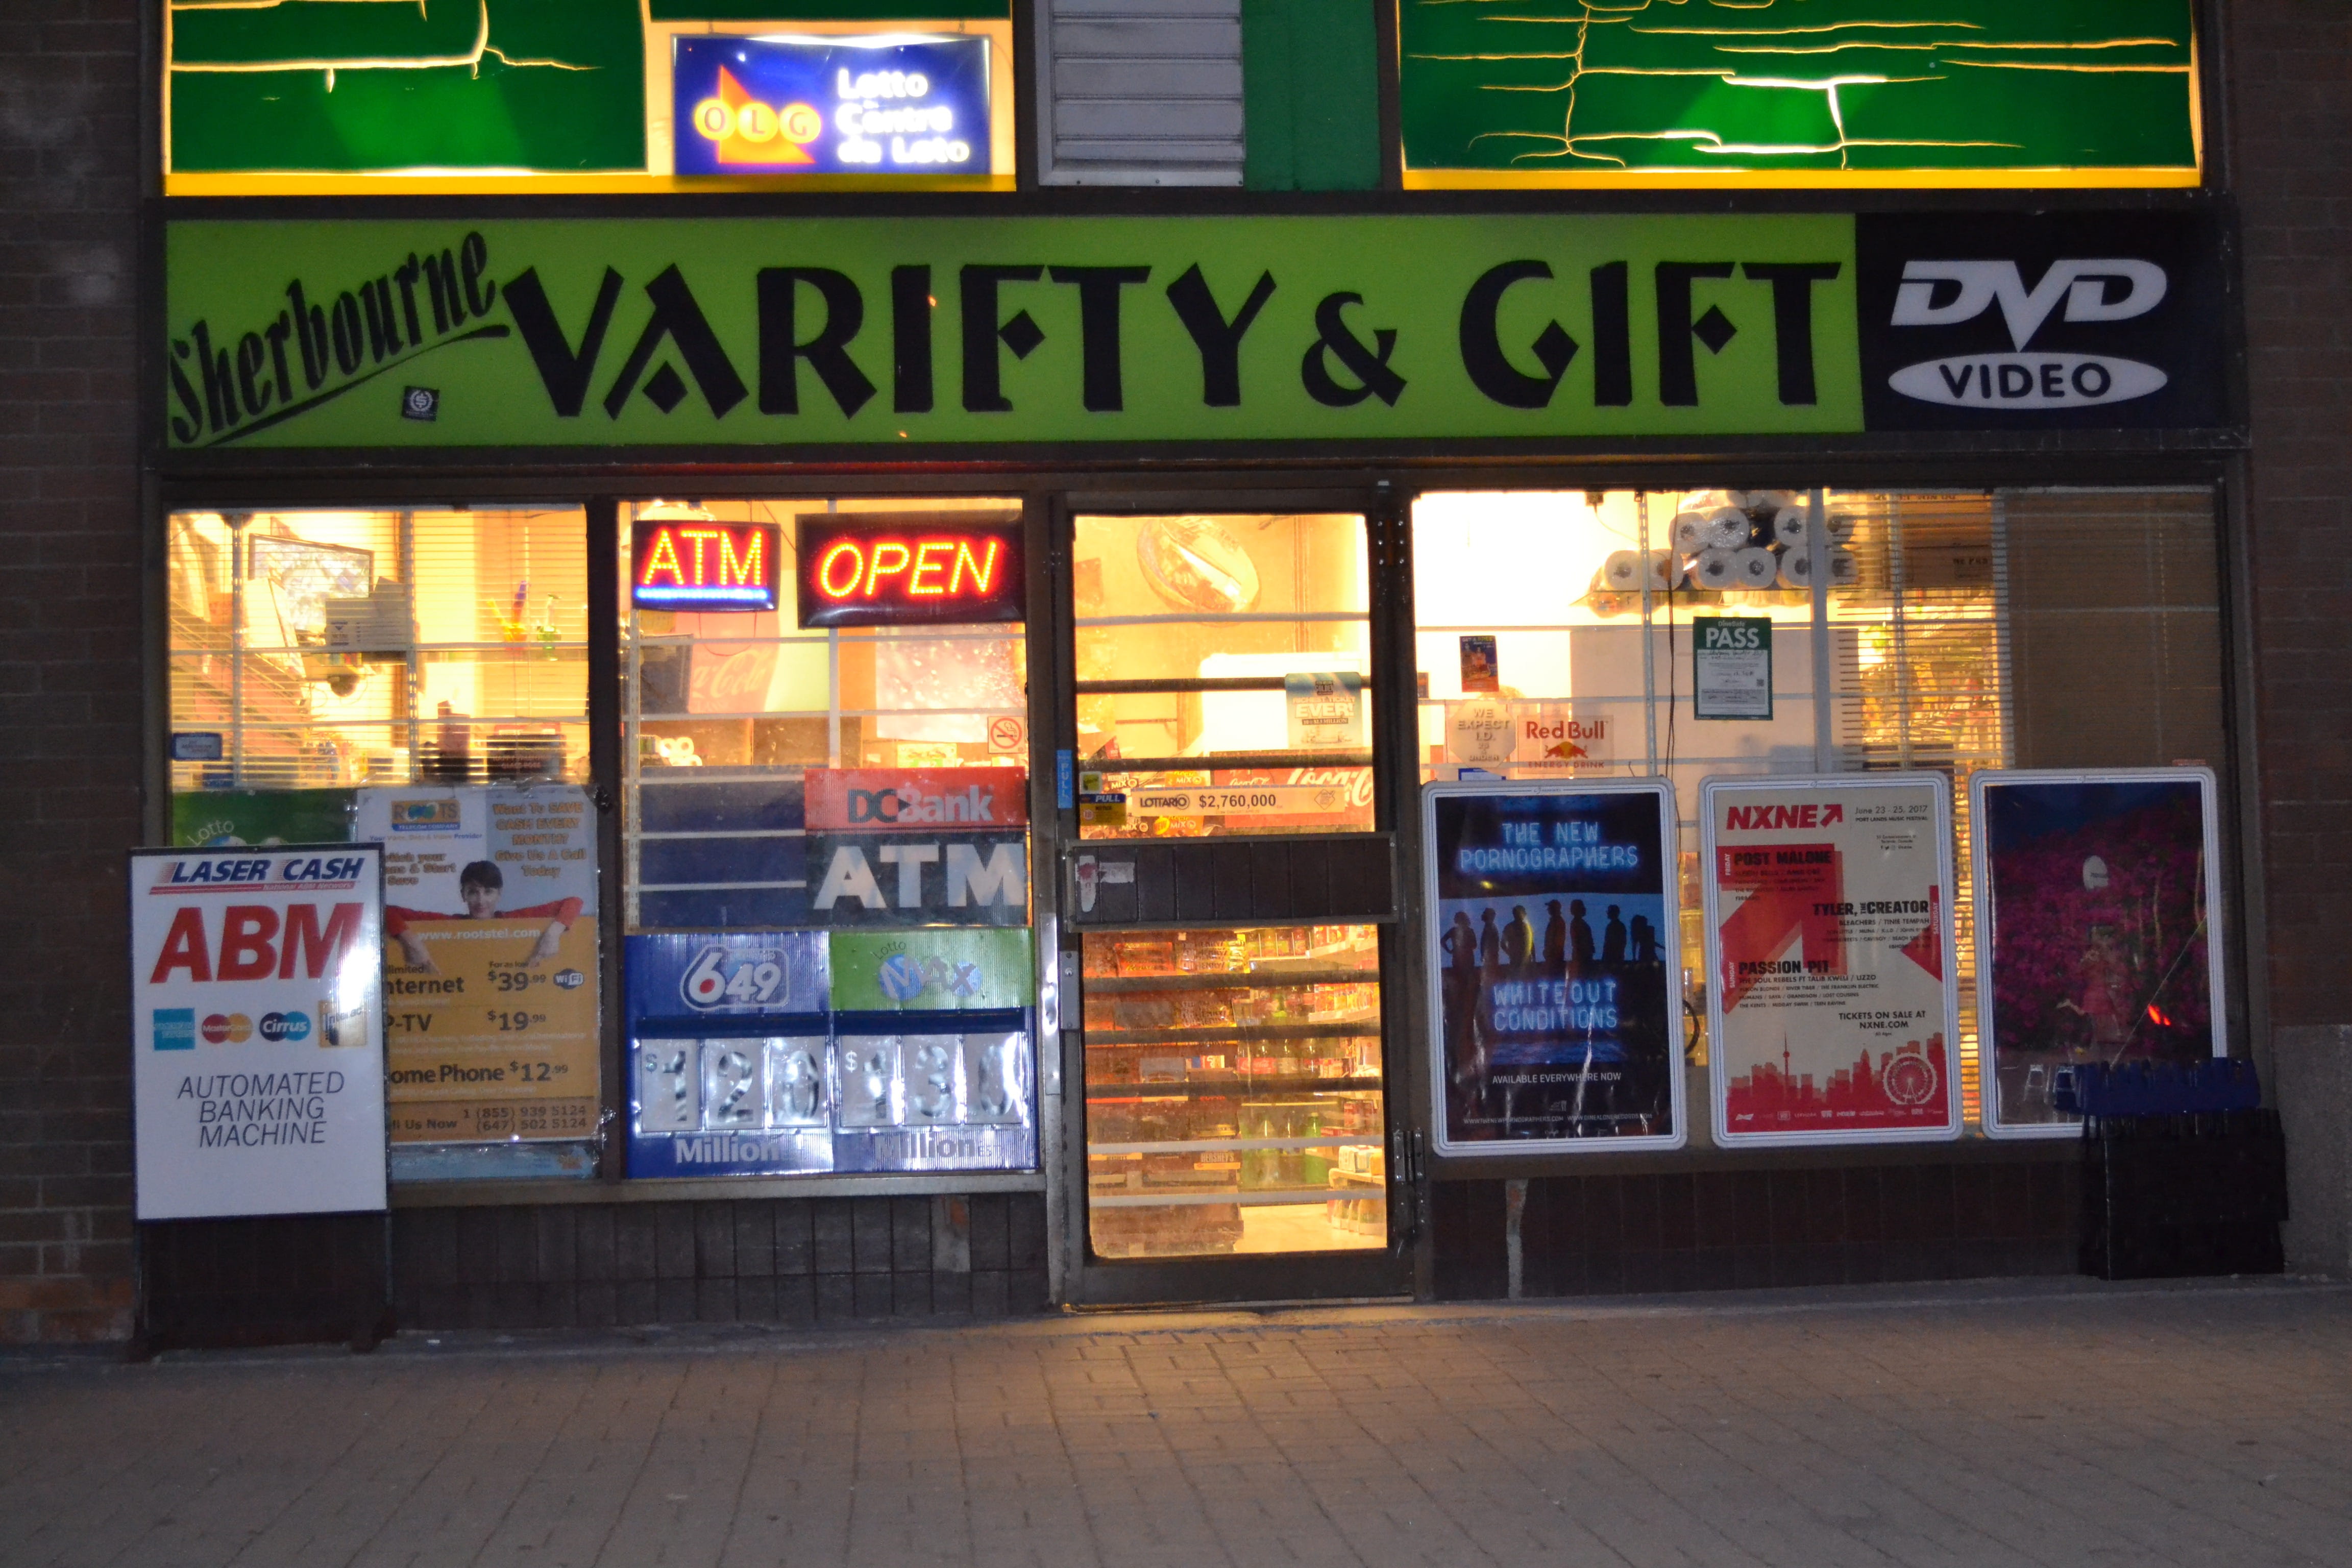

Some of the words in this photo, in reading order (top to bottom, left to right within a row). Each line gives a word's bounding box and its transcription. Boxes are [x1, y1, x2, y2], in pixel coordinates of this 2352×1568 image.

[838, 67, 928, 100] Lotto
[699, 104, 814, 139] OLG
[892, 140, 970, 163] Loto
[1890, 260, 2167, 354] DVD
[170, 231, 496, 444] Sherbourne
[1302, 289, 1407, 408] &
[1458, 258, 1842, 409] GIFT
[1939, 361, 2113, 399] VIDEO
[643, 528, 762, 587] ATM
[819, 541, 997, 598] OPEN
[1706, 627, 1760, 648] PASS
[1295, 702, 1355, 718] EVER!
[1474, 708, 1494, 718] WE
[1458, 720, 1510, 730] EXPECT
[1526, 721, 1564, 739] Red
[1568, 720, 1605, 739] Bull
[1111, 781, 1127, 789] MIX
[493, 804, 527, 815] Want
[529, 802, 546, 814] To
[548, 801, 584, 813] SAVE
[1095, 794, 1120, 802] PULL
[1140, 795, 1190, 810] LOTTARIO
[1199, 794, 1276, 809] $2,760,000
[496, 818, 534, 830] CASH
[536, 818, 580, 829] EVERY
[1726, 804, 1819, 830] NXNE
[1875, 806, 1886, 814] 23
[1893, 805, 1905, 815] 25,
[1909, 805, 1928, 814] 2017
[187, 820, 234, 846] Lotto
[1502, 823, 1540, 843] THE
[1555, 822, 1598, 843] NEW
[495, 850, 525, 862] Give
[527, 849, 546, 861] Us
[548, 849, 559, 860] A
[561, 848, 587, 860] Call
[1461, 846, 1638, 869] PORNOGRAPHERS
[1735, 852, 1770, 866] POST
[1776, 851, 1832, 865] MALONE
[172, 859, 271, 883] LASER
[283, 857, 365, 881] CASH
[521, 865, 561, 878] Today
[813, 843, 1027, 910] ATM
[262, 883, 296, 891] National
[317, 881, 353, 889] Network
[1813, 902, 1857, 917] TYLER,
[1867, 900, 1928, 914] CREATOR
[150, 902, 364, 984] ABM
[872, 941, 906, 960] Lotto
[880, 955, 976, 1000] MAX
[1739, 961, 1802, 974] PASSION
[1807, 960, 1829, 973] PIT
[487, 970, 547, 992] $39.99
[1493, 981, 1618, 1006] WHITEOUT
[487, 1009, 547, 1031] $19.99
[1494, 1008, 1618, 1031] CONDITIONS
[1839, 1012, 1873, 1020] TICKETS
[1893, 1011, 1913, 1019] SALE
[1916, 1010, 1926, 1018] AT
[1859, 1020, 1909, 1029] NXNE.COM
[203, 1022, 253, 1032] MasterCard
[263, 1020, 307, 1033] Cirrus
[439, 1064, 504, 1083] Phone
[510, 1060, 569, 1082] $12.99
[1492, 1075, 1537, 1085] AVAILABLE
[1540, 1073, 1598, 1083] EVERYWHERE
[1601, 1072, 1622, 1081] NOW
[178, 1071, 345, 1099] AUTOMATED
[200, 1096, 325, 1123] BANKING
[200, 1121, 327, 1147] MACHINE
[406, 1119, 423, 1130] Us
[427, 1118, 458, 1129] Now
[676, 1135, 779, 1163] Million
[874, 1132, 976, 1160] Million
[1201, 1152, 1234, 1163] HERSHEY'S
